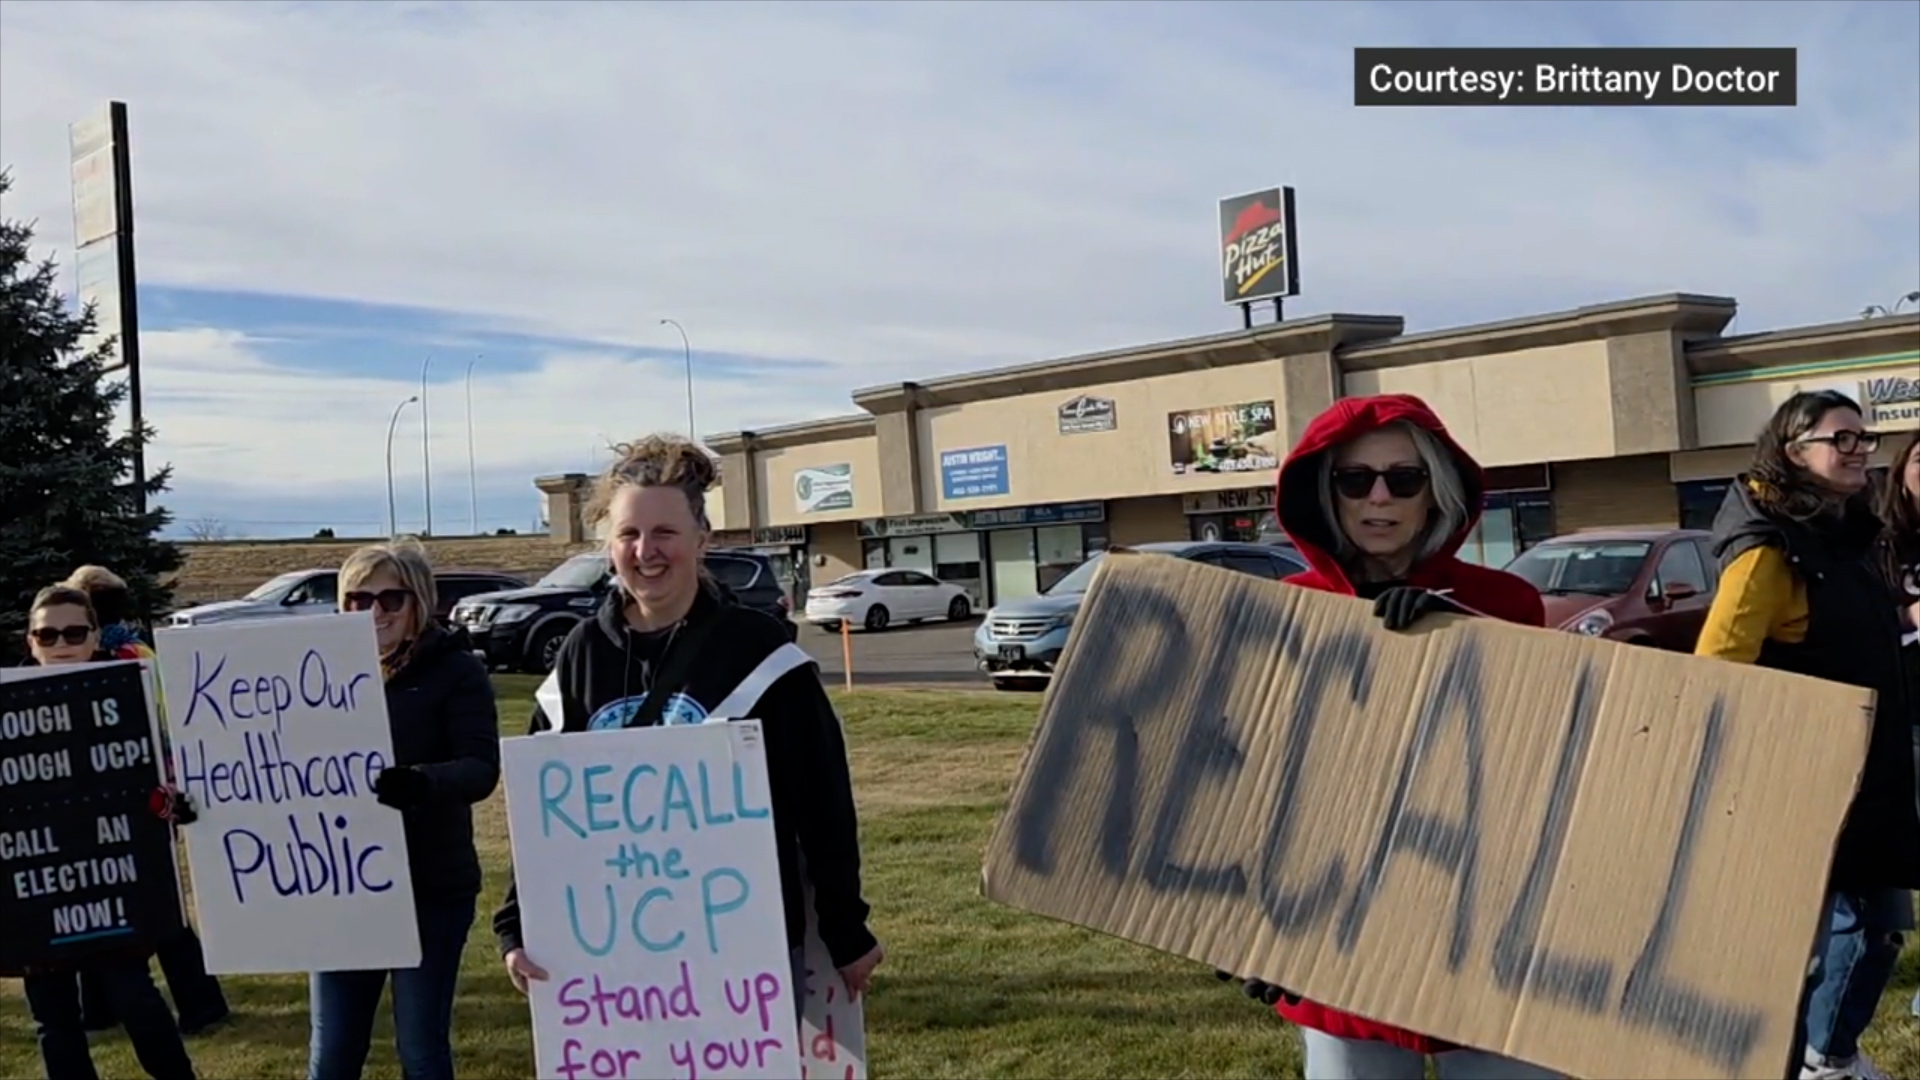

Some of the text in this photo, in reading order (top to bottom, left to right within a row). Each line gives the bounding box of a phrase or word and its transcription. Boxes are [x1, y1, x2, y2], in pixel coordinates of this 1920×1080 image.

[1224, 222, 1283, 279] Pizza
[1235, 242, 1280, 284] Hut
[1188, 406, 1273, 429] NEW STYLE SPA
[1217, 489, 1248, 508] NEW
[183, 648, 371, 730] Keep Our
[0, 698, 120, 741] OUGH IS
[0, 736, 151, 786] OUGH UCP!
[180, 731, 386, 808] Healthcare
[538, 760, 770, 839] RECALL
[0, 814, 131, 860] CALL AN
[1015, 584, 1762, 1071] RECALL
[14, 854, 138, 899] ELECTION
[223, 812, 394, 904] Public
[605, 843, 690, 880] the
[53, 896, 128, 934] NOW!
[567, 867, 750, 957] UCP
[723, 971, 782, 1033] up
[555, 1036, 783, 1080] for your
